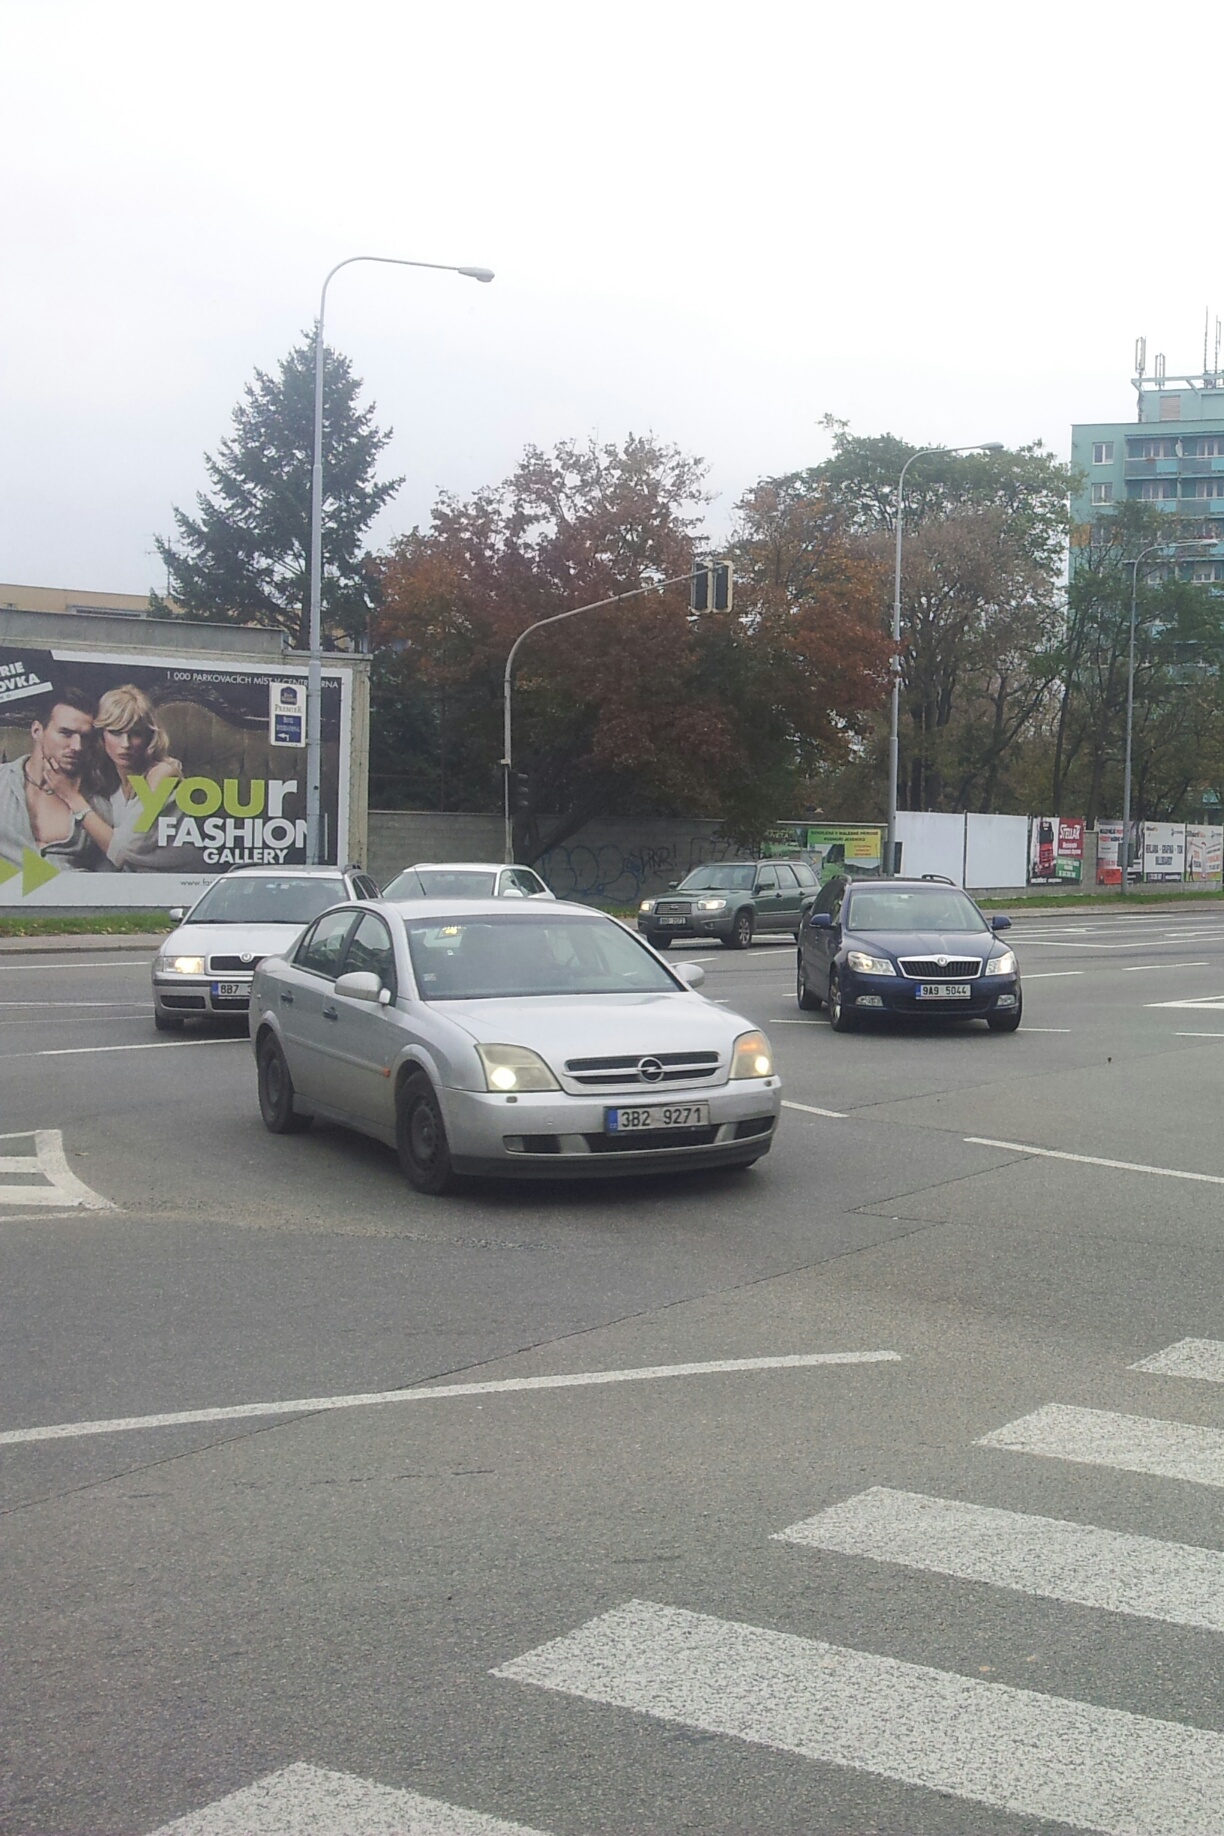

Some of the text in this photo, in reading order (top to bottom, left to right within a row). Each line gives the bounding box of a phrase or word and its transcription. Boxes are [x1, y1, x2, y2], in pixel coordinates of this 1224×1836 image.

[192, 671, 251, 684] PARKOVACÍCH
[253, 674, 273, 685] MÍST
[127, 775, 298, 833] your
[203, 848, 288, 864] GALLERY
[220, 984, 240, 995] 8B7
[922, 986, 967, 995] 9A9 5044
[621, 1107, 702, 1128] 3B2 9271
